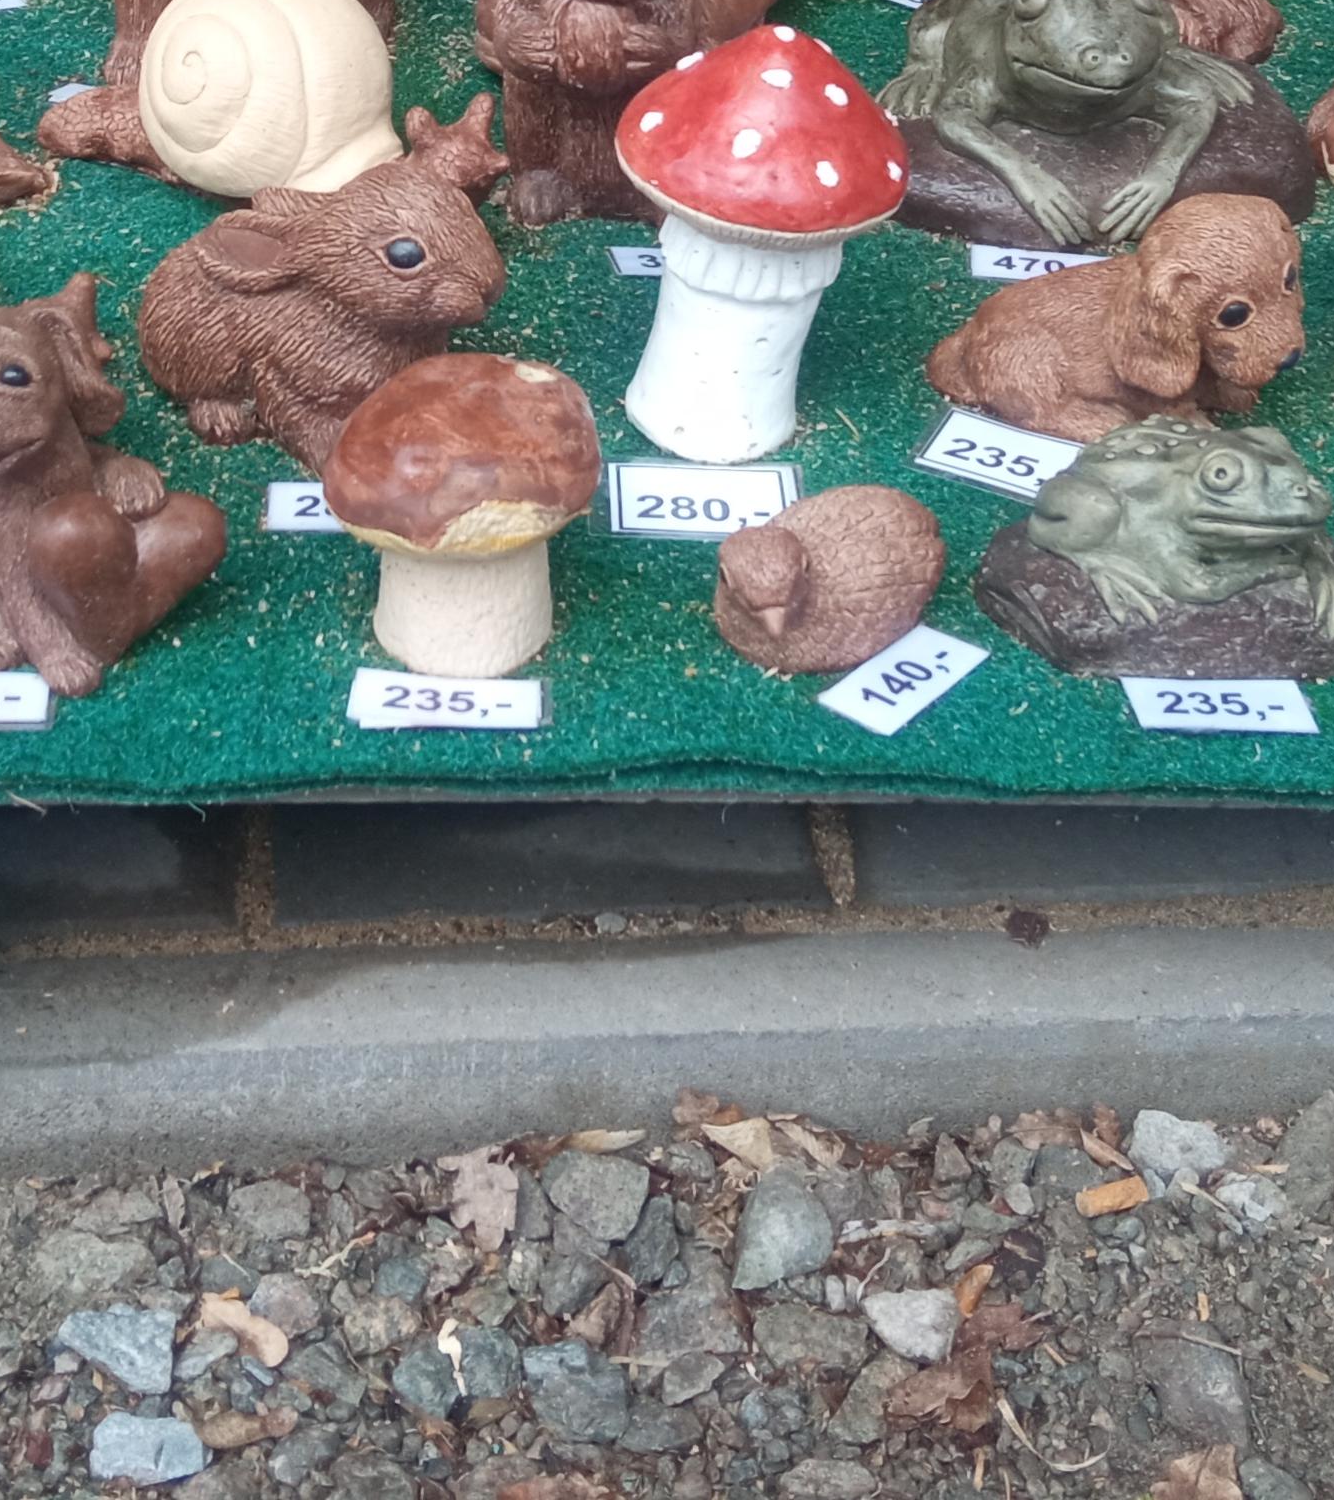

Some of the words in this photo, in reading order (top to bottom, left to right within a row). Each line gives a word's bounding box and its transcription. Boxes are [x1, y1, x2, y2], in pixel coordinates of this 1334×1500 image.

[993, 255, 1065, 273] 470
[943, 438, 1046, 486] 235,
[636, 495, 770, 528] 280,-
[861, 651, 950, 706] 140,-
[382, 685, 512, 717] 235,-
[1156, 691, 1285, 721] 235,-
